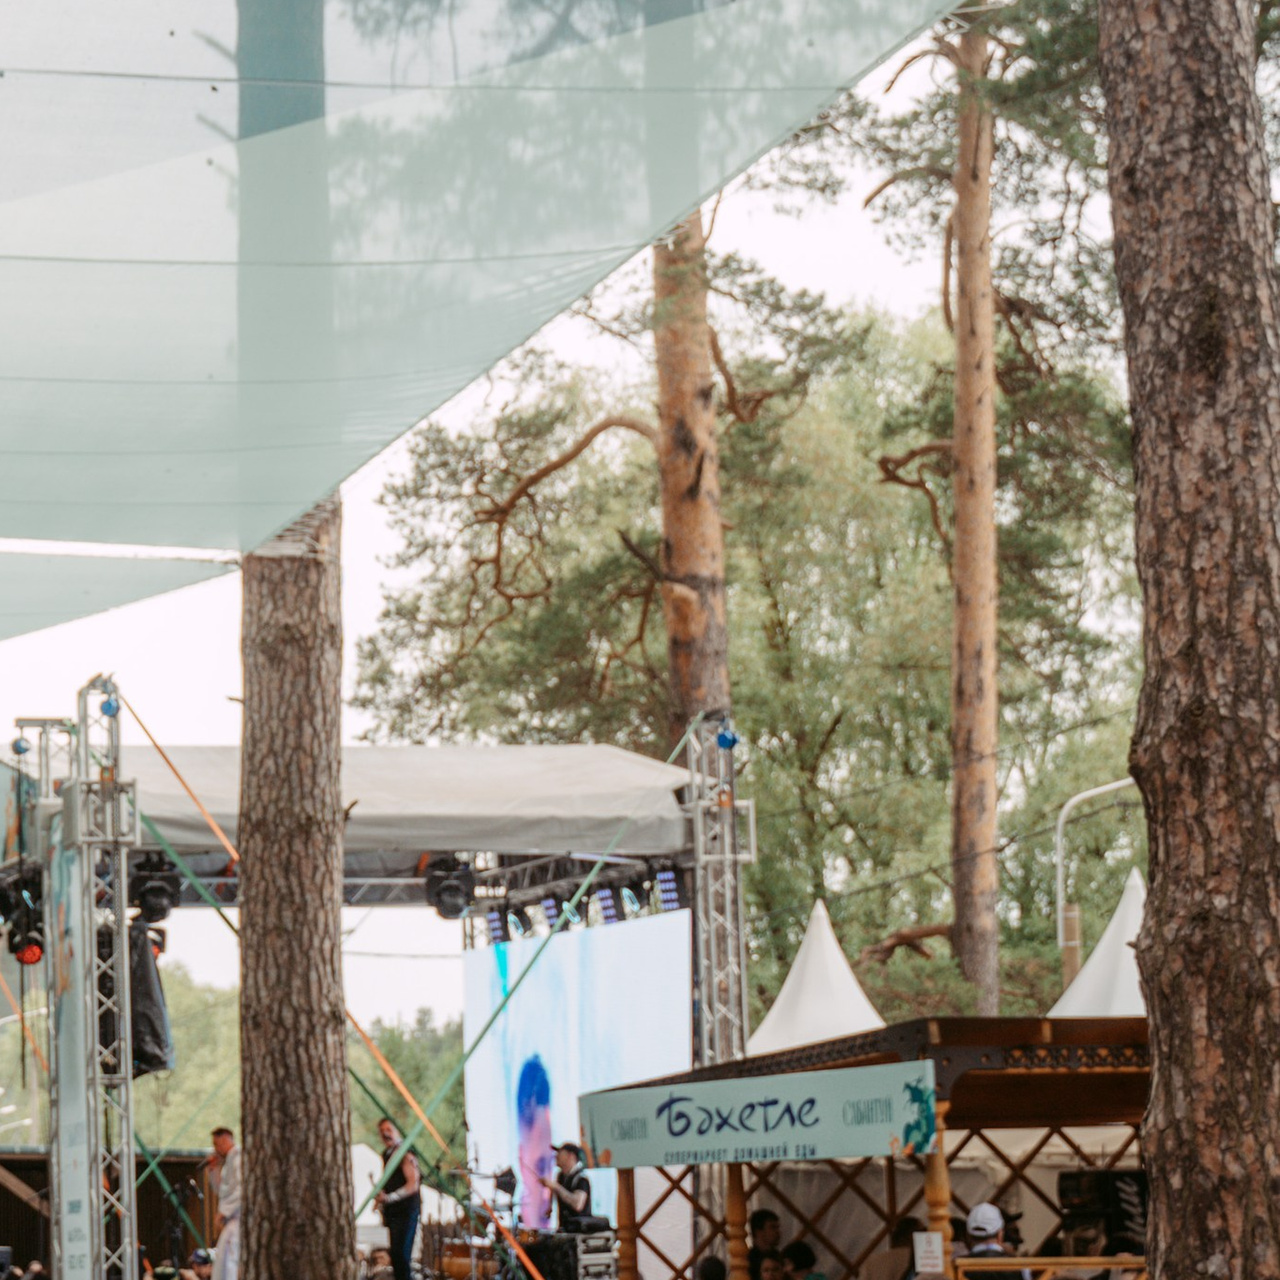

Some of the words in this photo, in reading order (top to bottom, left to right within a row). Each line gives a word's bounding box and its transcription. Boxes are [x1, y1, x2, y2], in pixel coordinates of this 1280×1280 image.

[842, 1095, 893, 1127] САБАНТУЙ
[664, 1148, 727, 1164] СУПЕРМАРКЕТ
[734, 1142, 788, 1161] ДОМАШНЕЙ
[795, 1143, 816, 1160] ЕДЫ
